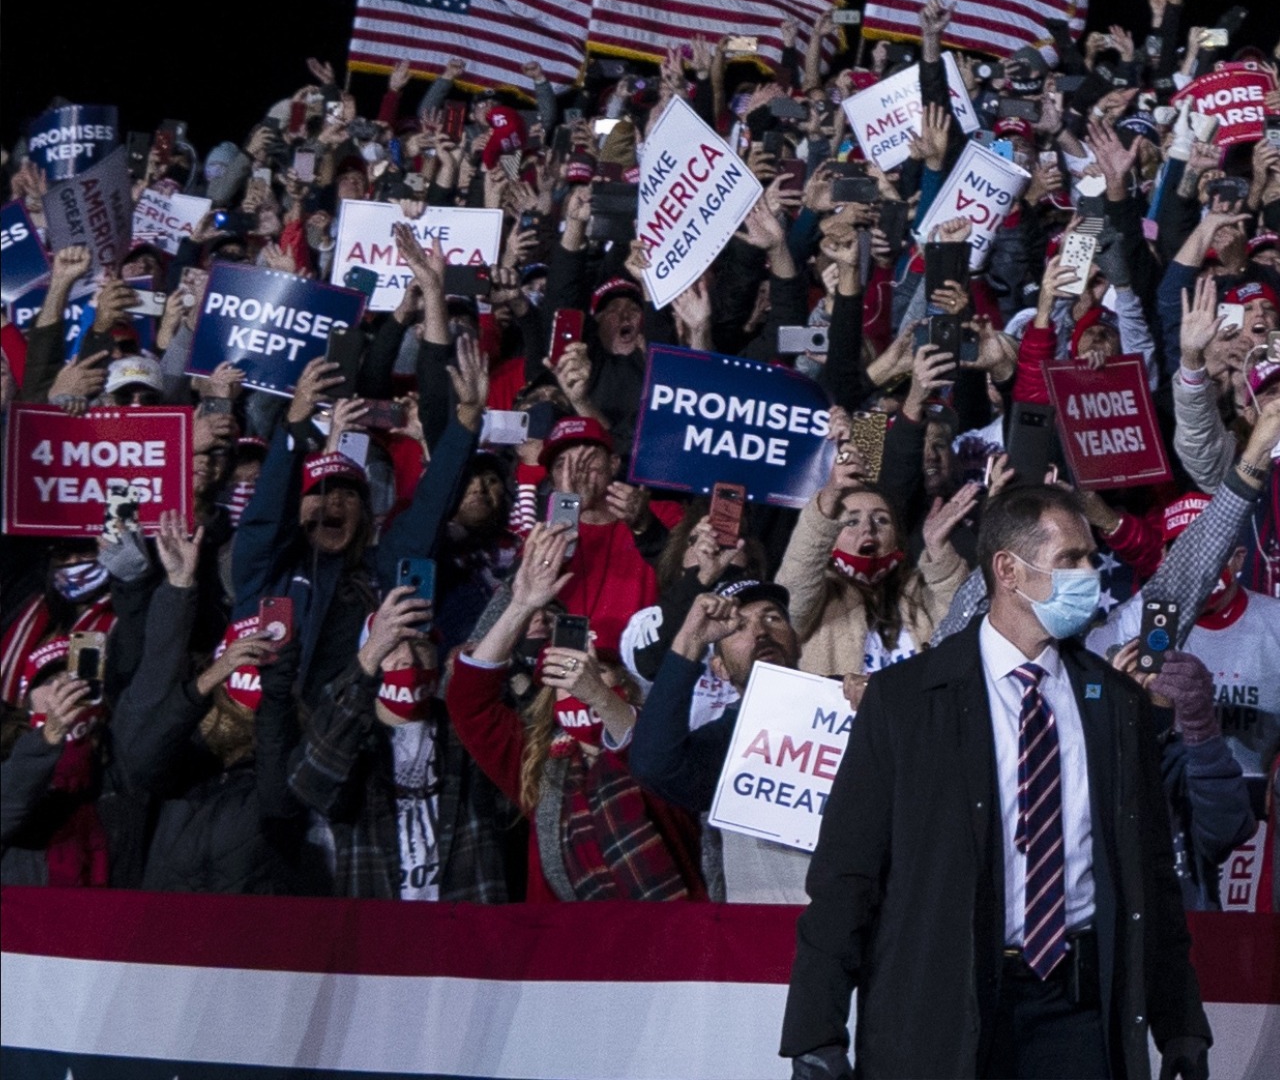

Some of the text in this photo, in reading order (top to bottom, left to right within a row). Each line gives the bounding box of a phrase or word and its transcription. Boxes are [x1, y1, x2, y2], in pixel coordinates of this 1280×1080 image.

[1196, 85, 1265, 114] MORE
[864, 102, 924, 142] AMER
[1216, 106, 1266, 127] ARS!
[28, 123, 115, 152] PROMISES
[46, 142, 96, 162] KEPT
[638, 149, 678, 205] MAKE
[964, 169, 1012, 207] GAIN
[638, 143, 725, 260] AMERICA
[654, 162, 743, 281] GREAT AGAIN
[375, 274, 413, 291] EAT
[226, 324, 306, 362] KEPT
[651, 384, 831, 437] PROMISES
[1066, 390, 1139, 419] 4 MORE
[31, 439, 167, 468] 4 MORE
[683, 425, 790, 466] MADE
[1075, 426, 1147, 458] YEARS!
[811, 706, 852, 736] MA
